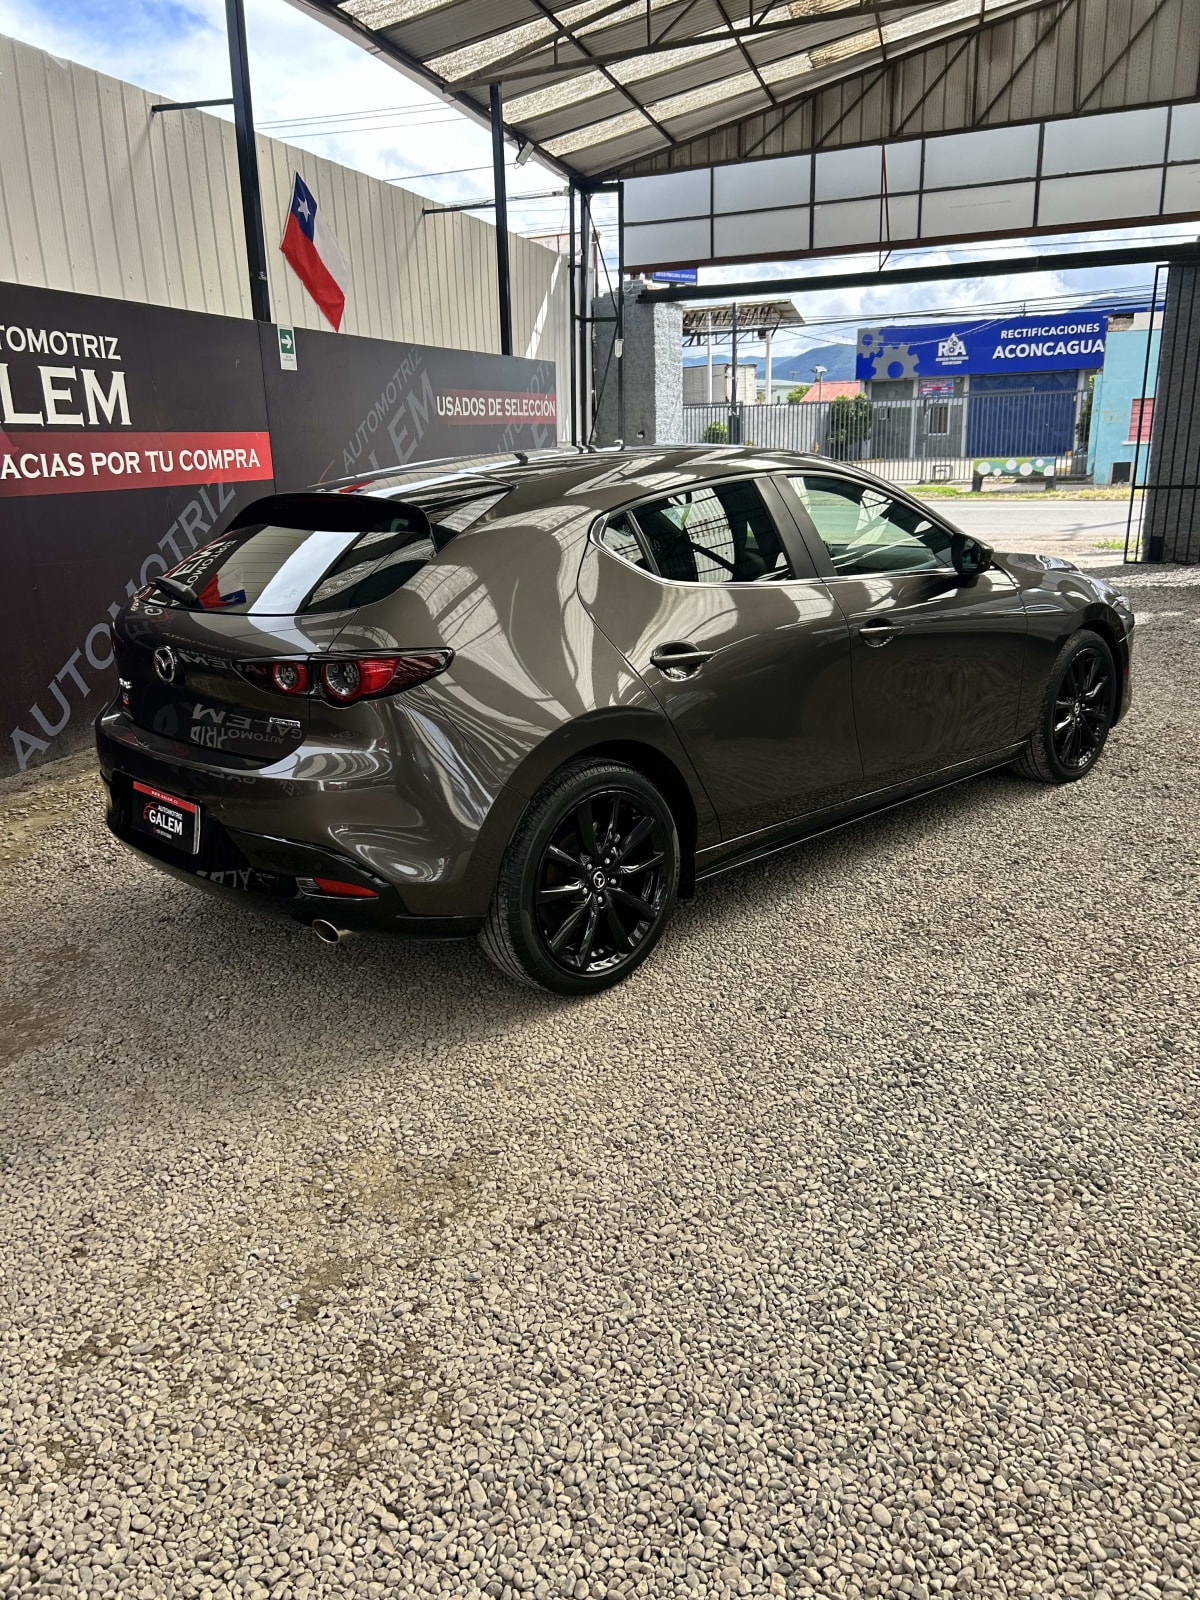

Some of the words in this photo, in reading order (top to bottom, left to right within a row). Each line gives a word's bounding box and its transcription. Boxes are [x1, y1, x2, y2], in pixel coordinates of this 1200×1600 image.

[1000, 323, 1100, 339] RECTIFICACIONES
[992, 338, 1105, 360] ACONCAGUA
[342, 346, 422, 475] AUTOMOTRIZ
[436, 396, 486, 417] USADOS
[488, 397, 503, 416] DE
[504, 394, 556, 417] SELECCIÓN
[0, 453, 85, 480] ACIAS
[91, 451, 142, 476] POR
[145, 450, 174, 473] TU
[179, 448, 261, 471] COMPRA
[149, 809, 183, 836] GALEM
